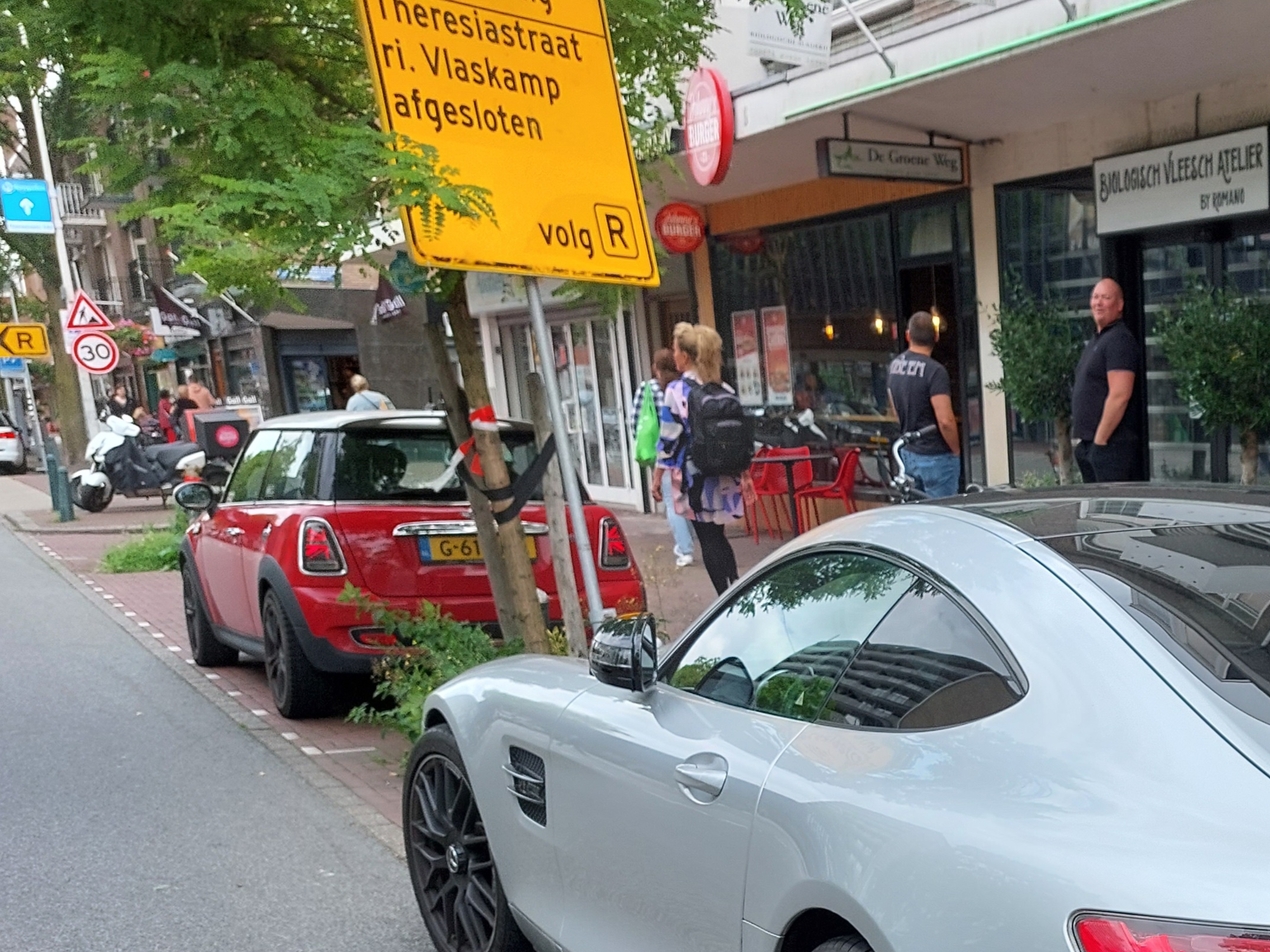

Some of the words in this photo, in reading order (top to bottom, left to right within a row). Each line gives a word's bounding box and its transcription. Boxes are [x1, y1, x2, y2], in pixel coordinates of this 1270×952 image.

[382, 39, 415, 72] ri.
[420, 44, 561, 105] Vlaskamp
[394, 89, 543, 140] afgesloten
[687, 116, 721, 148] BURGER
[868, 148, 884, 162] De
[888, 149, 930, 166] Groene
[932, 153, 957, 172] Weg
[1099, 164, 1161, 202] BIOLOGISCH
[1163, 151, 1214, 184] VLEESCH
[1217, 142, 1263, 184] ATELIER
[1200, 193, 1210, 210] BY
[1212, 188, 1245, 212] ROMANO
[539, 220, 595, 258] volg
[605, 214, 629, 249] R
[662, 224, 702, 237] BURGER
[17, 332, 34, 349] R
[80, 344, 110, 362] 30
[440, 540, 481, 556] G-61
